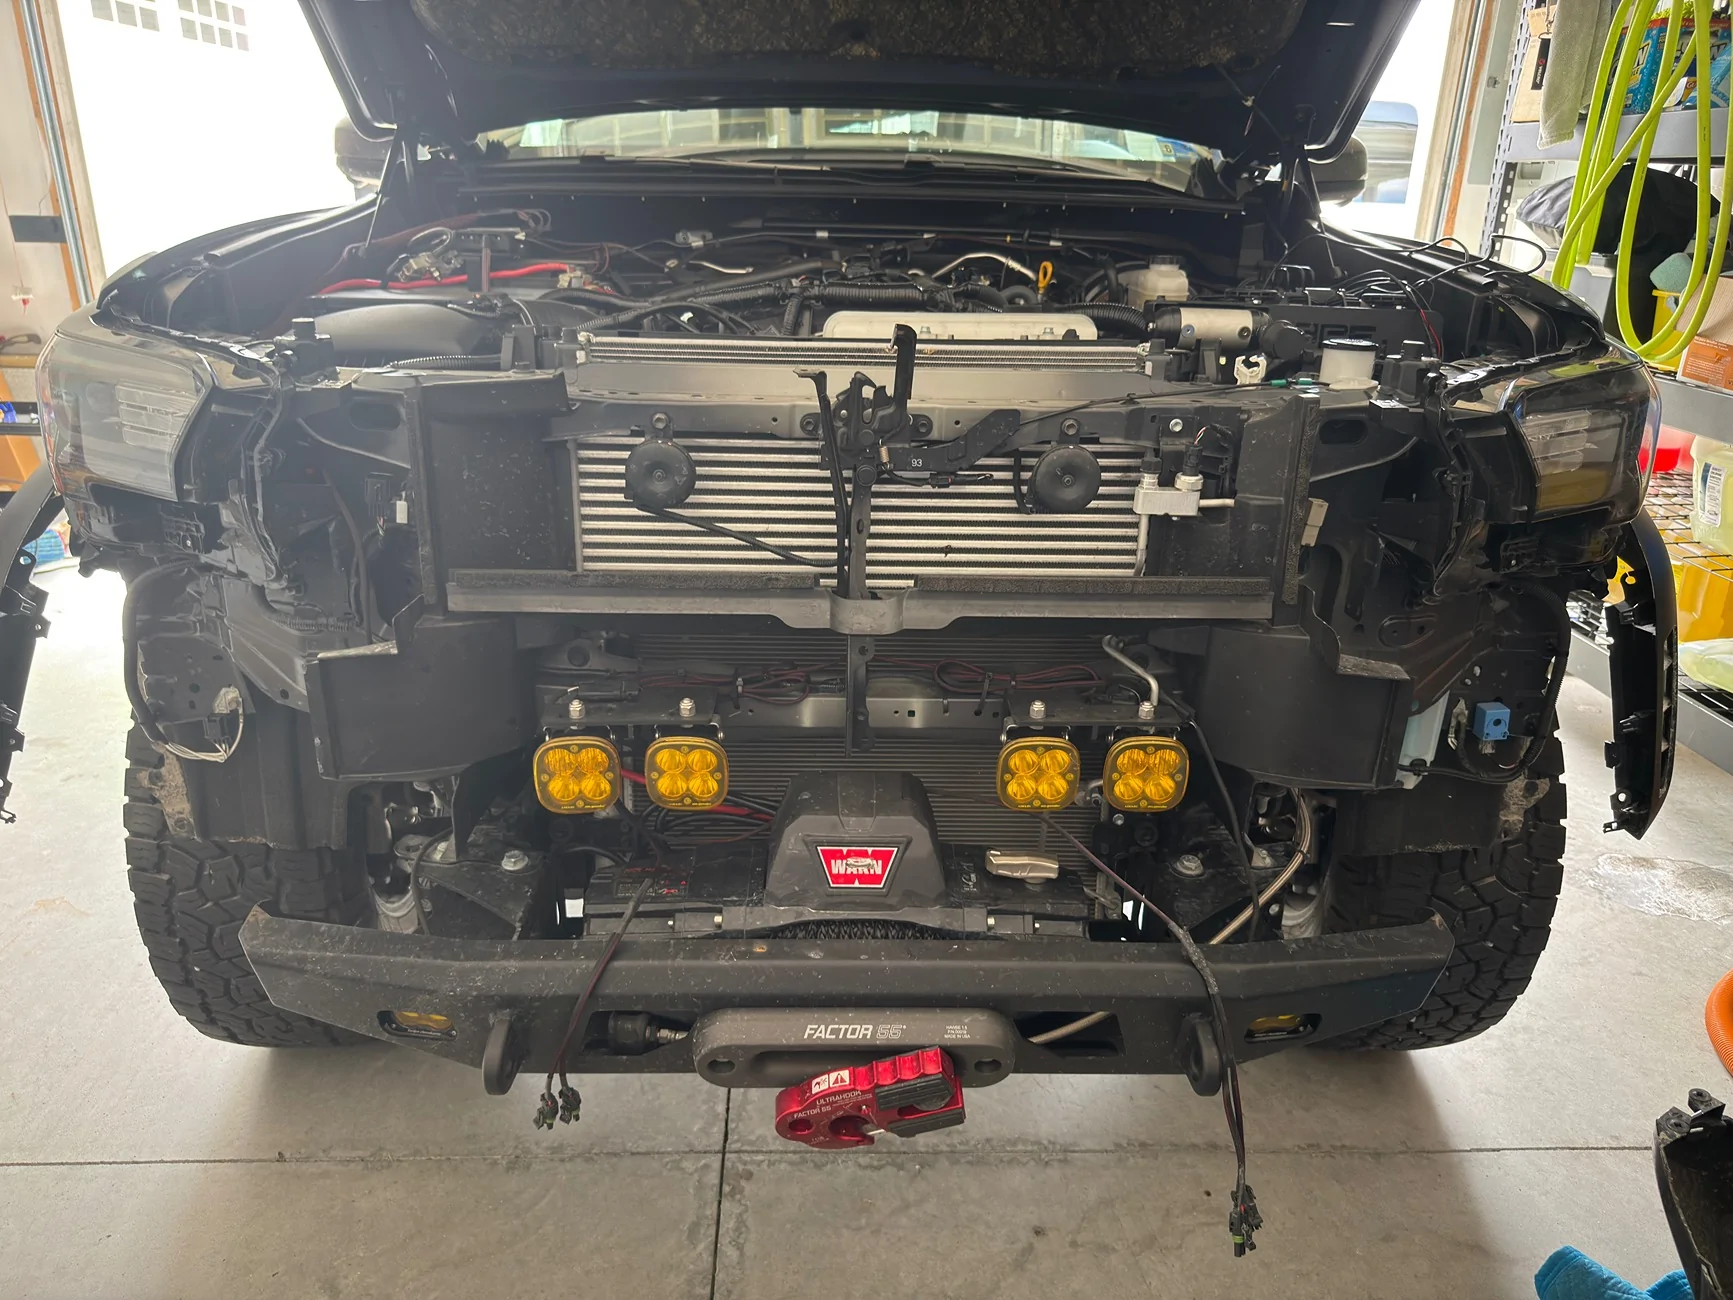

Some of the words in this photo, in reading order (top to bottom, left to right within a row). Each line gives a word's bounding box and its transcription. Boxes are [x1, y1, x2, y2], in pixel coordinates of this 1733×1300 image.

[911, 458, 923, 467] 93
[803, 1024, 873, 1039] FACTOR
[816, 1090, 862, 1105] ULTRAHOOK
[793, 1108, 820, 1119] FACTOR
[821, 1105, 832, 1113] 55
